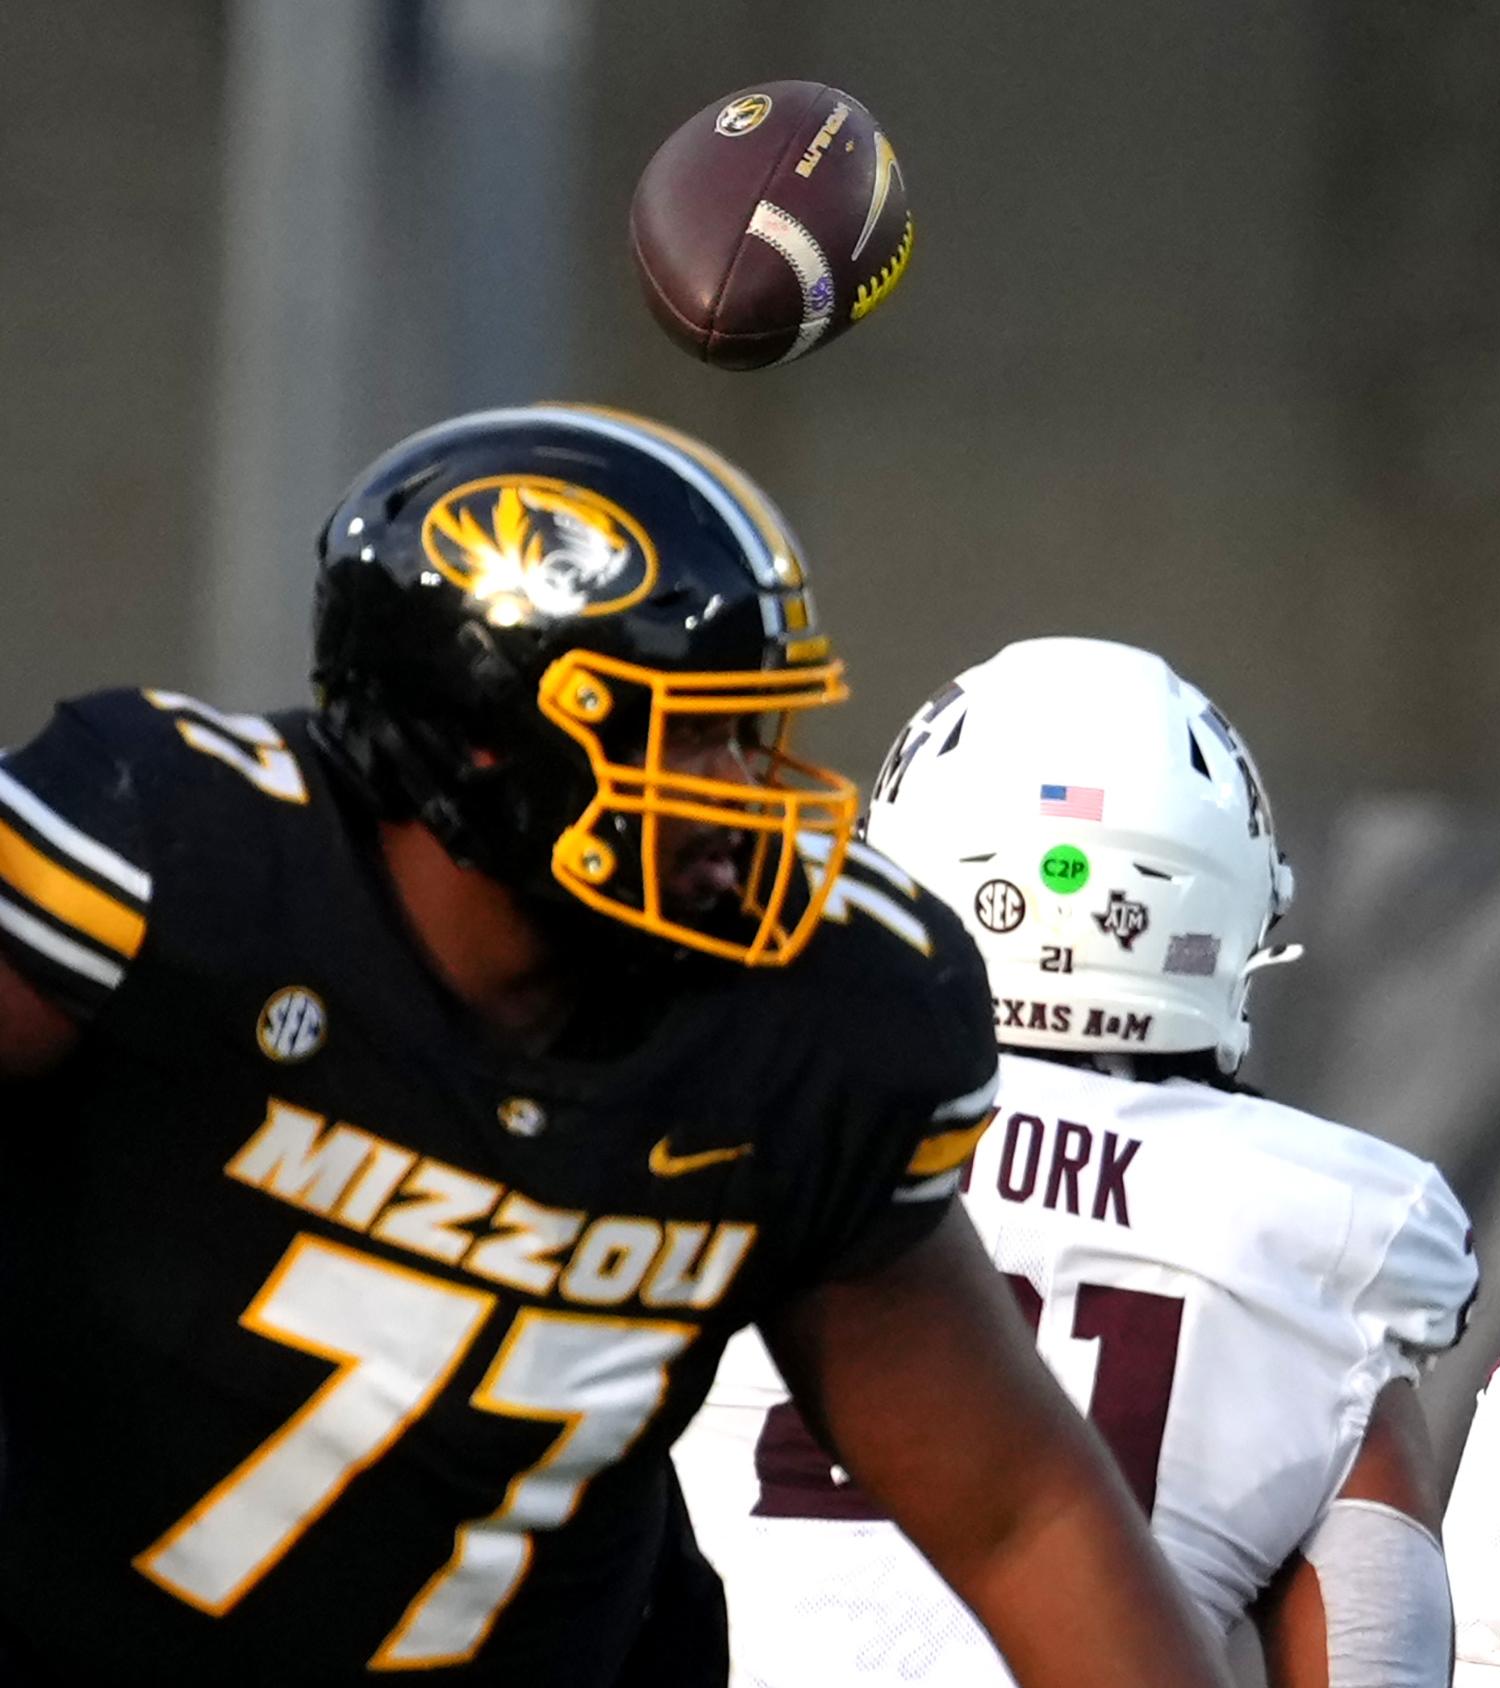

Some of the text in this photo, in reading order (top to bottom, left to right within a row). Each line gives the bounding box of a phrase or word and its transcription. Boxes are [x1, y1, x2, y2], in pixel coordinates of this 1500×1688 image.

[1042, 858, 1086, 879] C2P
[977, 881, 1023, 933] SEC
[1039, 945, 1074, 975] 21
[260, 987, 324, 1057] SEC
[223, 1097, 758, 1310] MIZZOU
[131, 1231, 700, 1672] 77
